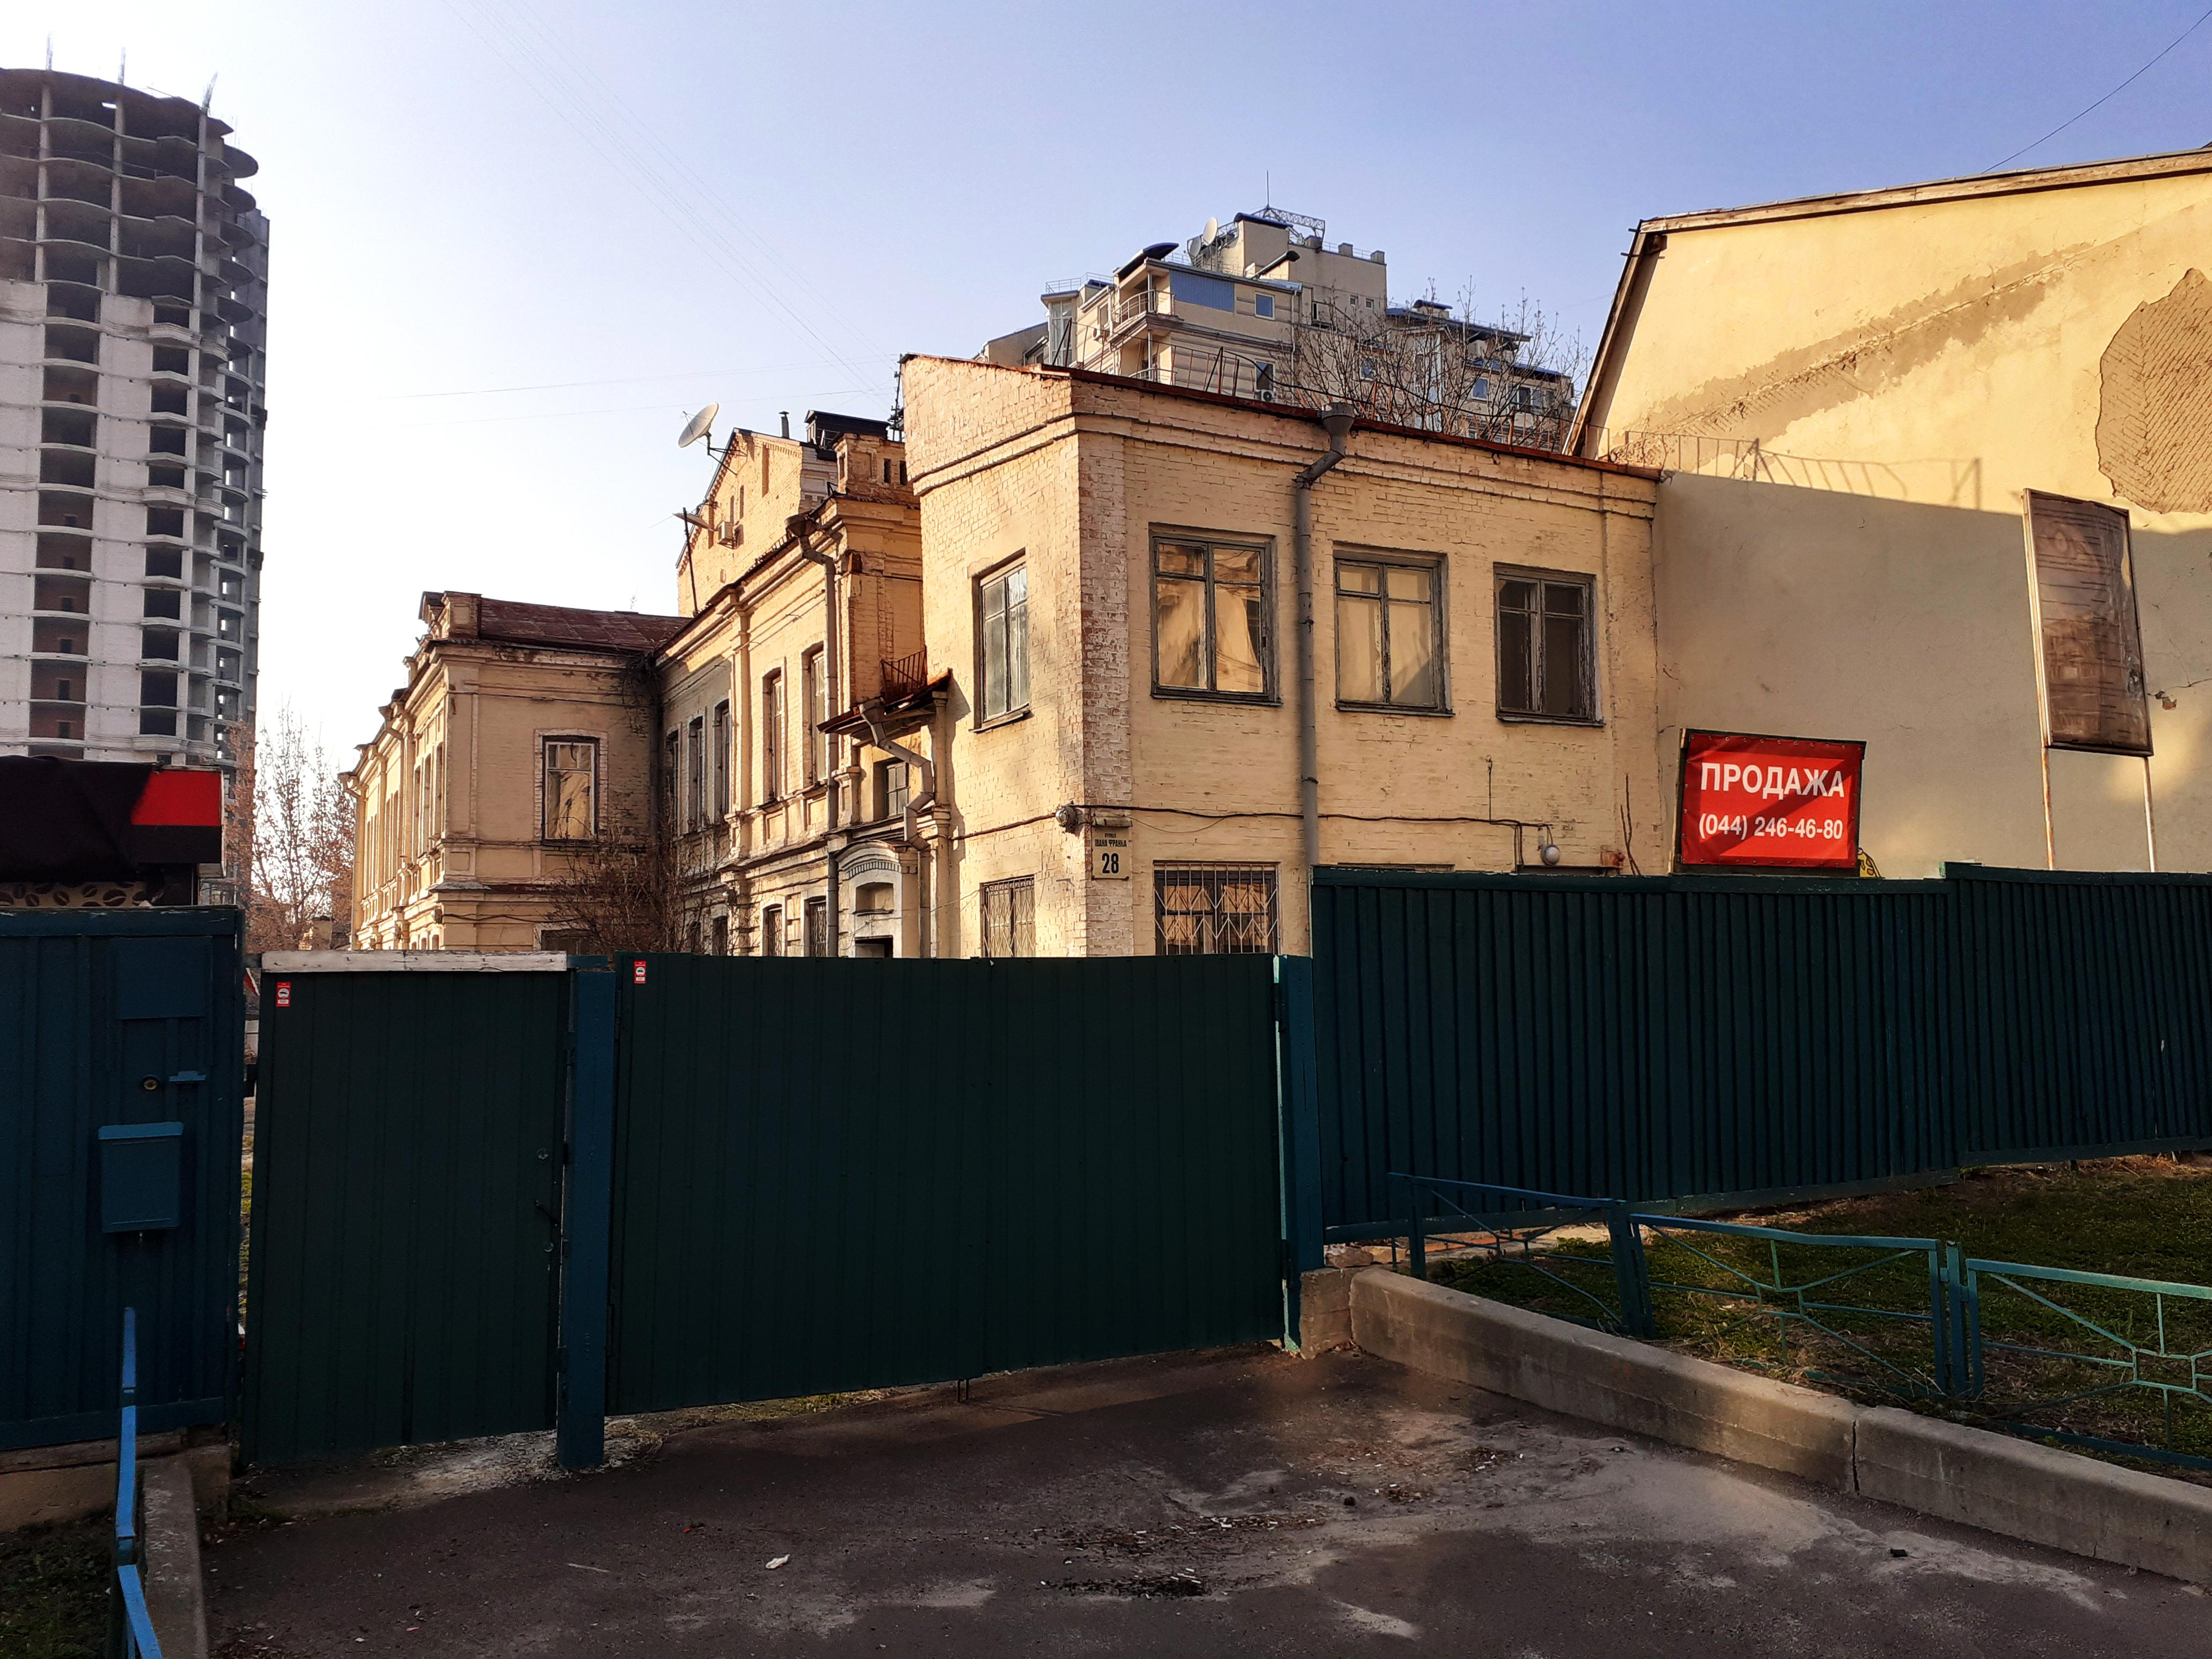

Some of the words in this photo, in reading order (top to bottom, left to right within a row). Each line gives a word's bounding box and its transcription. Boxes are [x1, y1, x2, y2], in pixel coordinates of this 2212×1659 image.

[1701, 762, 1844, 800] ПРОДАЖА
[1699, 813, 1747, 840] (044)
[1754, 816, 1843, 840] 246-46-80
[1102, 853, 1119, 874] 28
